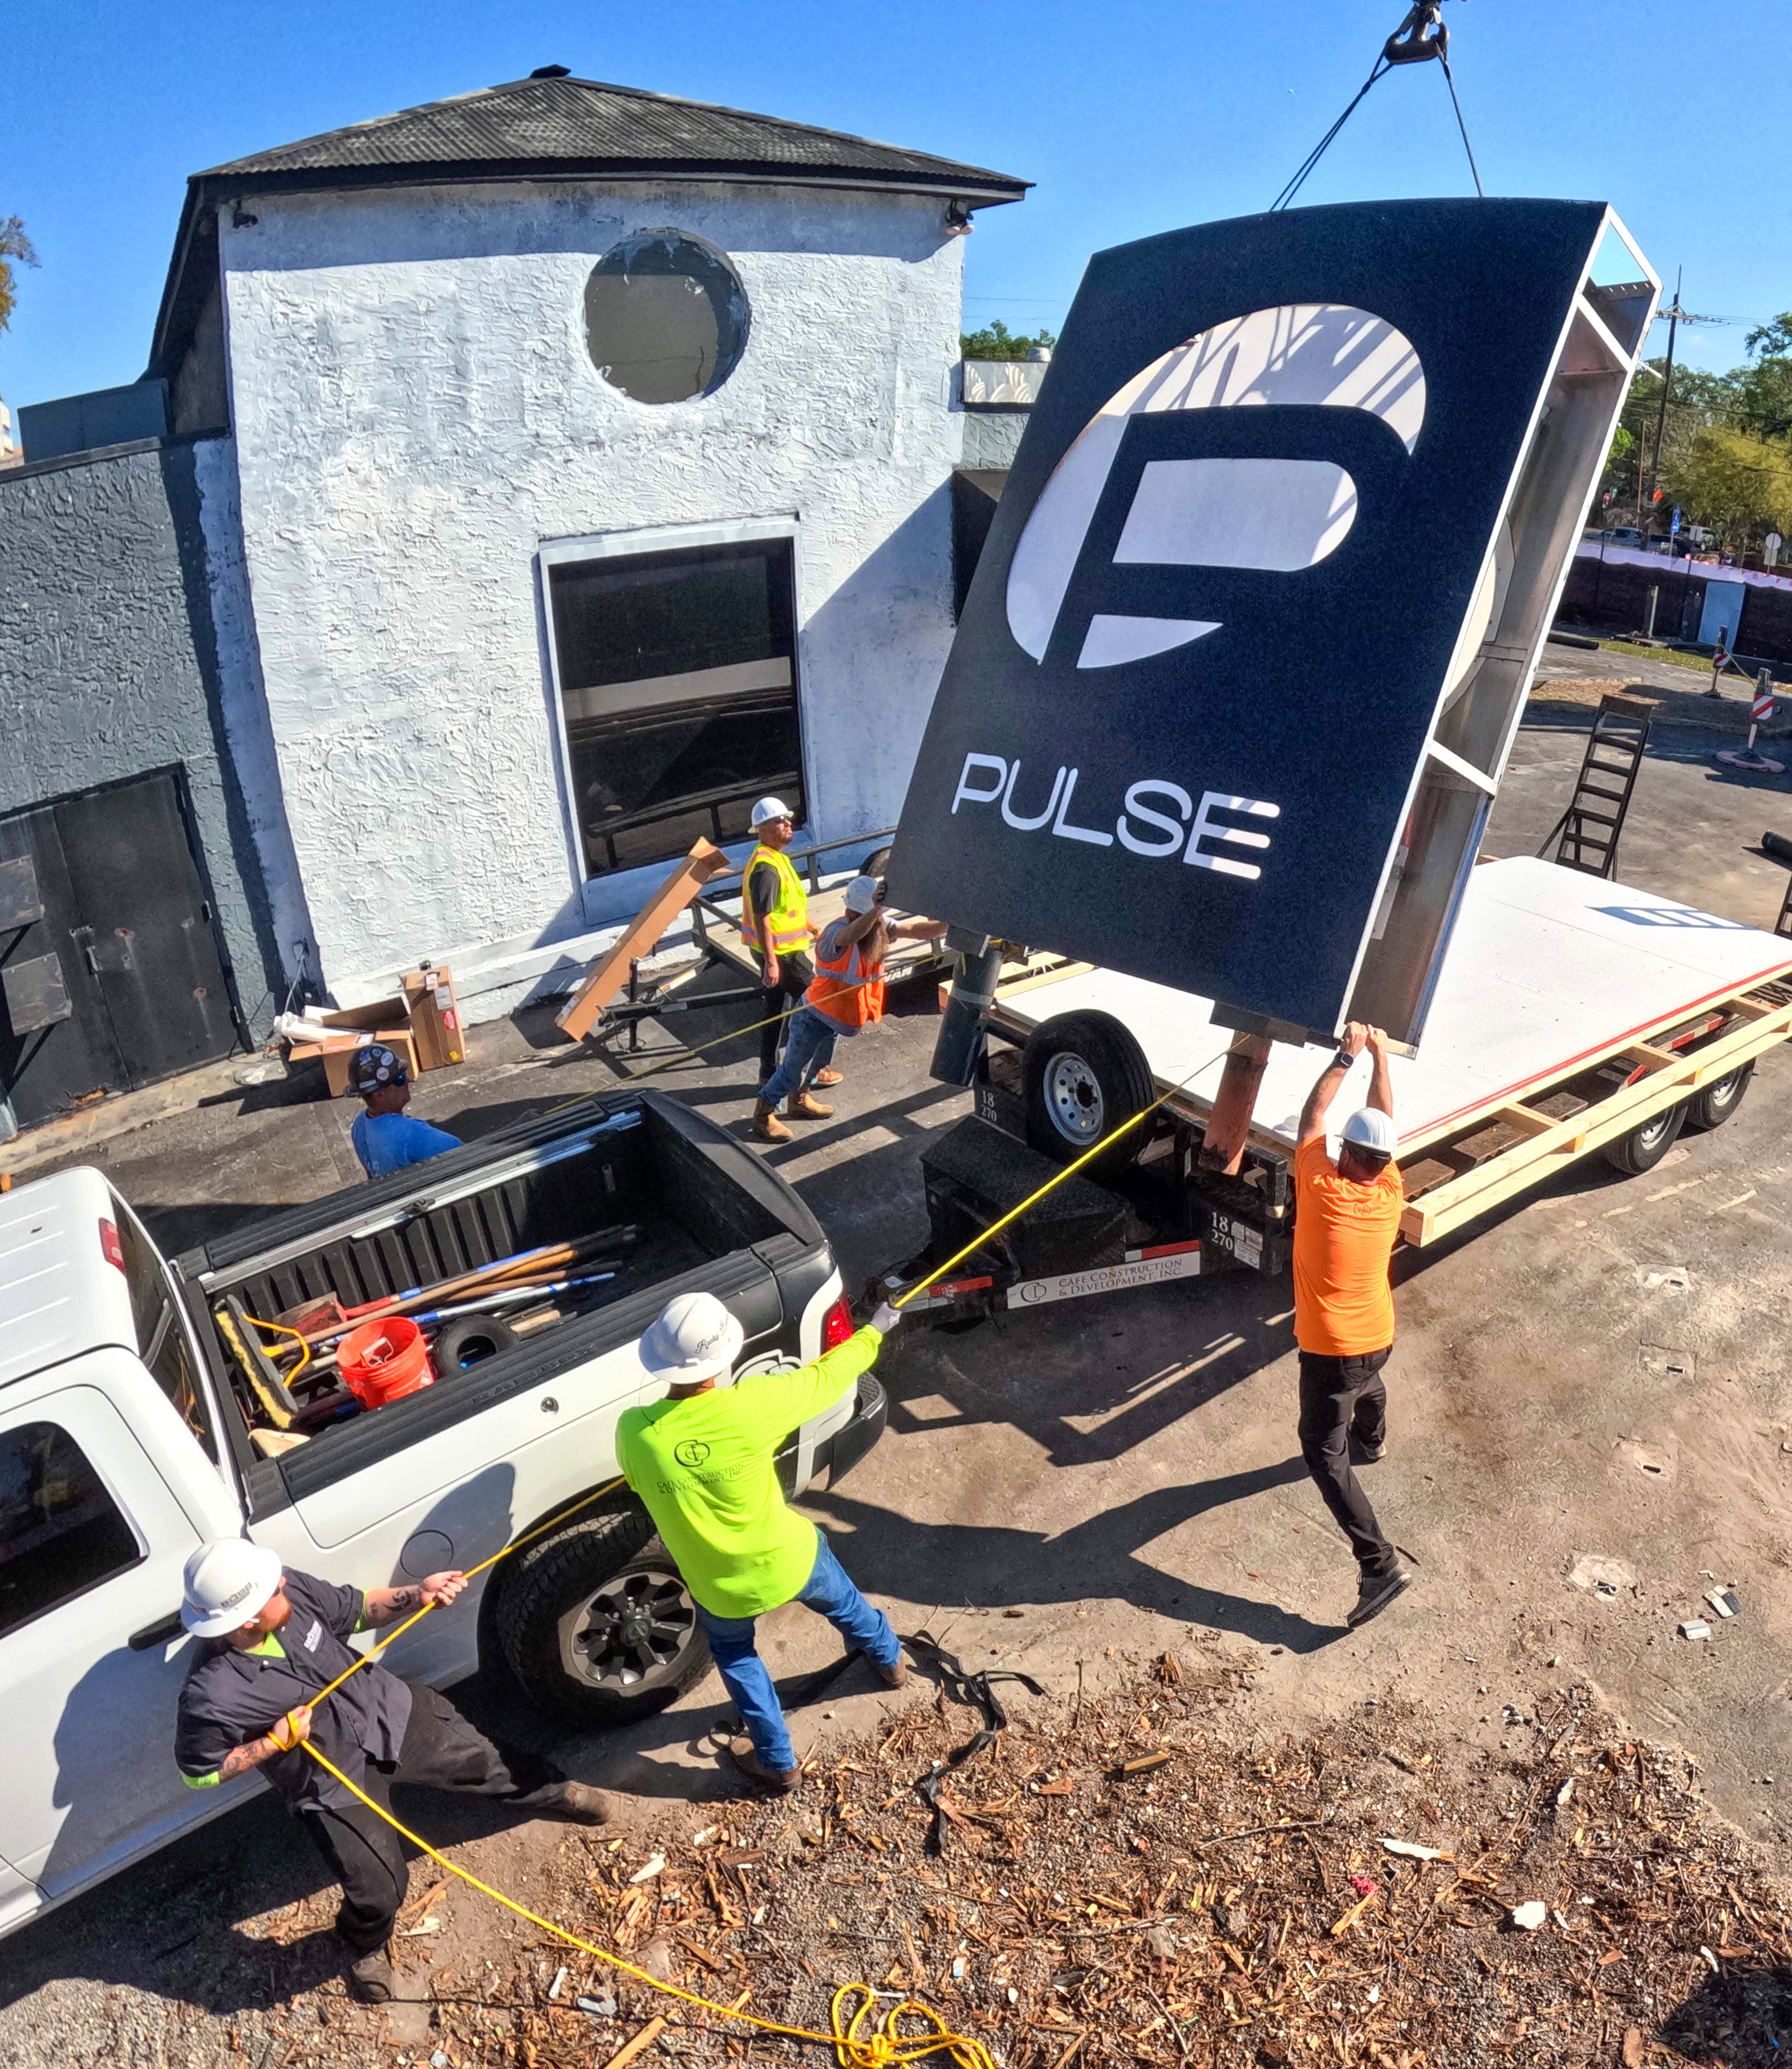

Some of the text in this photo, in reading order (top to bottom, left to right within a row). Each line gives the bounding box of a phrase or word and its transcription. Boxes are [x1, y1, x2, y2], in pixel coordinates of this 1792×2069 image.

[951, 752, 1280, 880] PULSE
[982, 1089, 995, 1108] 18
[981, 1104, 997, 1122] 270
[1211, 1212, 1229, 1232] 18
[1211, 1229, 1233, 1250] 270
[1059, 1258, 1182, 1287] CAFE CONSTRUCTION
